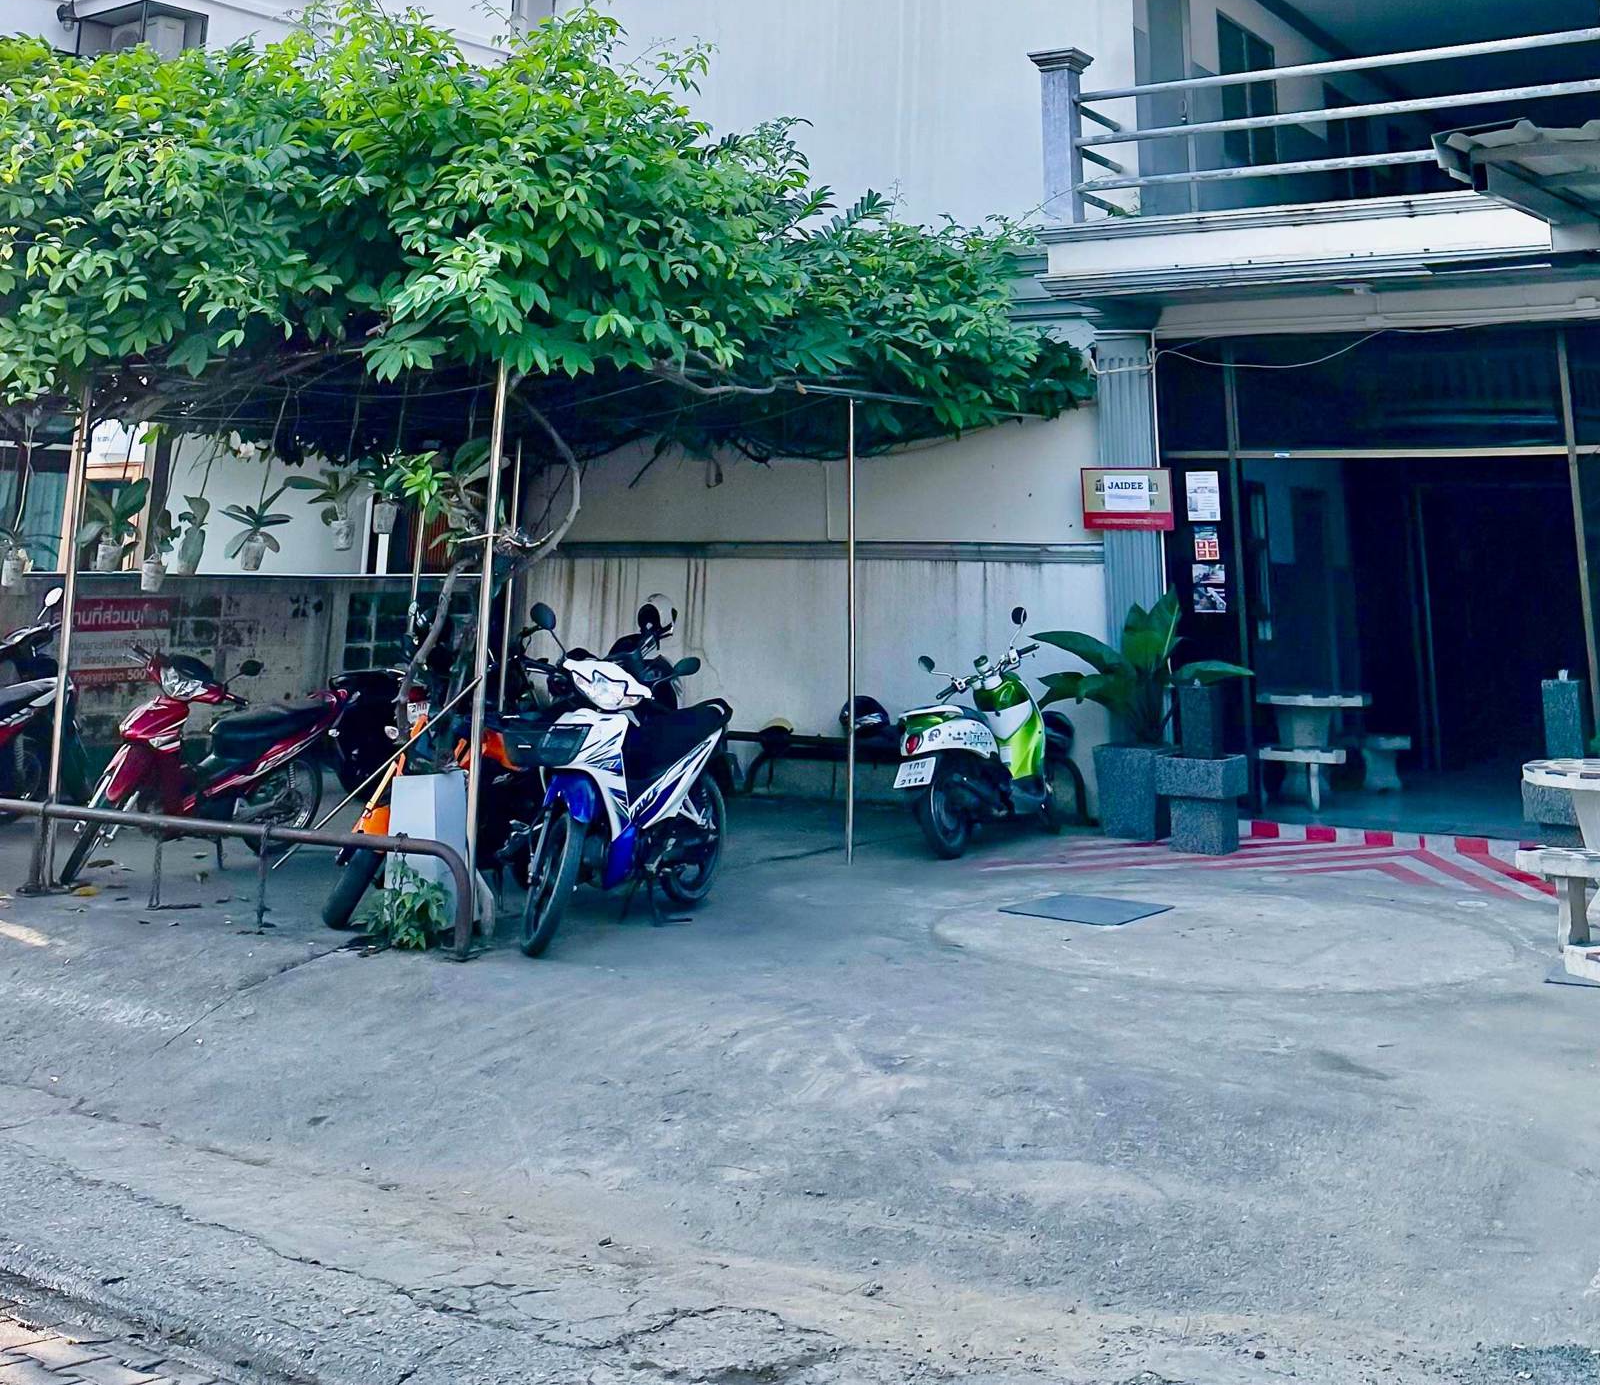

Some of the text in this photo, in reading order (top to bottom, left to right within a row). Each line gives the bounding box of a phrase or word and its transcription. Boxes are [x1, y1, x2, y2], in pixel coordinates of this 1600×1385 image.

[1107, 481, 1144, 490] JAIDEE
[127, 670, 146, 680] 500
[900, 777, 925, 785] 2114
